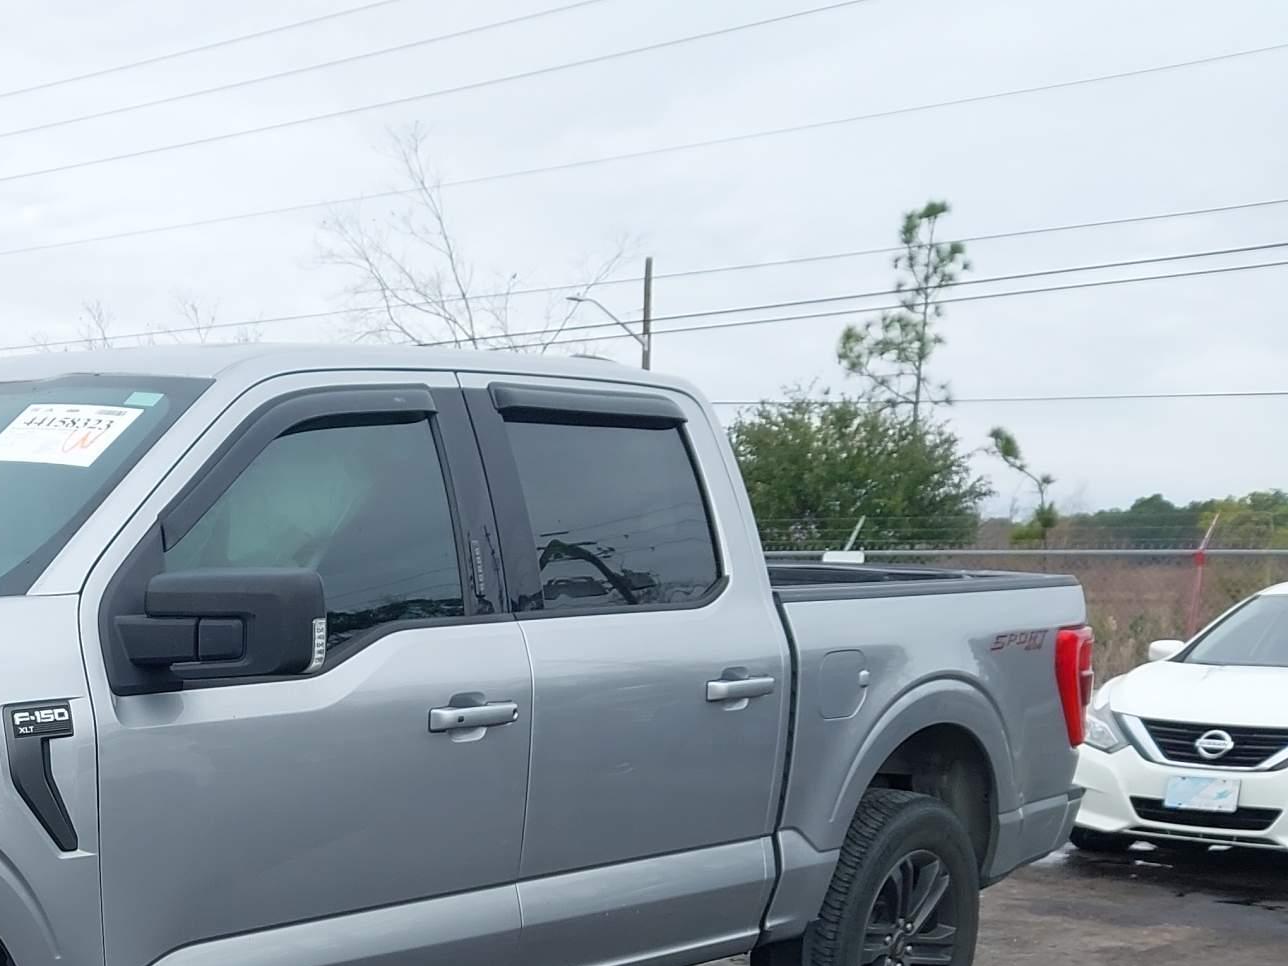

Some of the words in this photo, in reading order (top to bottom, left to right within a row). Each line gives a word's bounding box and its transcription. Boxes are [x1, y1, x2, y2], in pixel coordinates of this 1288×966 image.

[24, 415, 115, 431] 44158323
[13, 708, 70, 726] F-150
[18, 725, 35, 735] XLT
